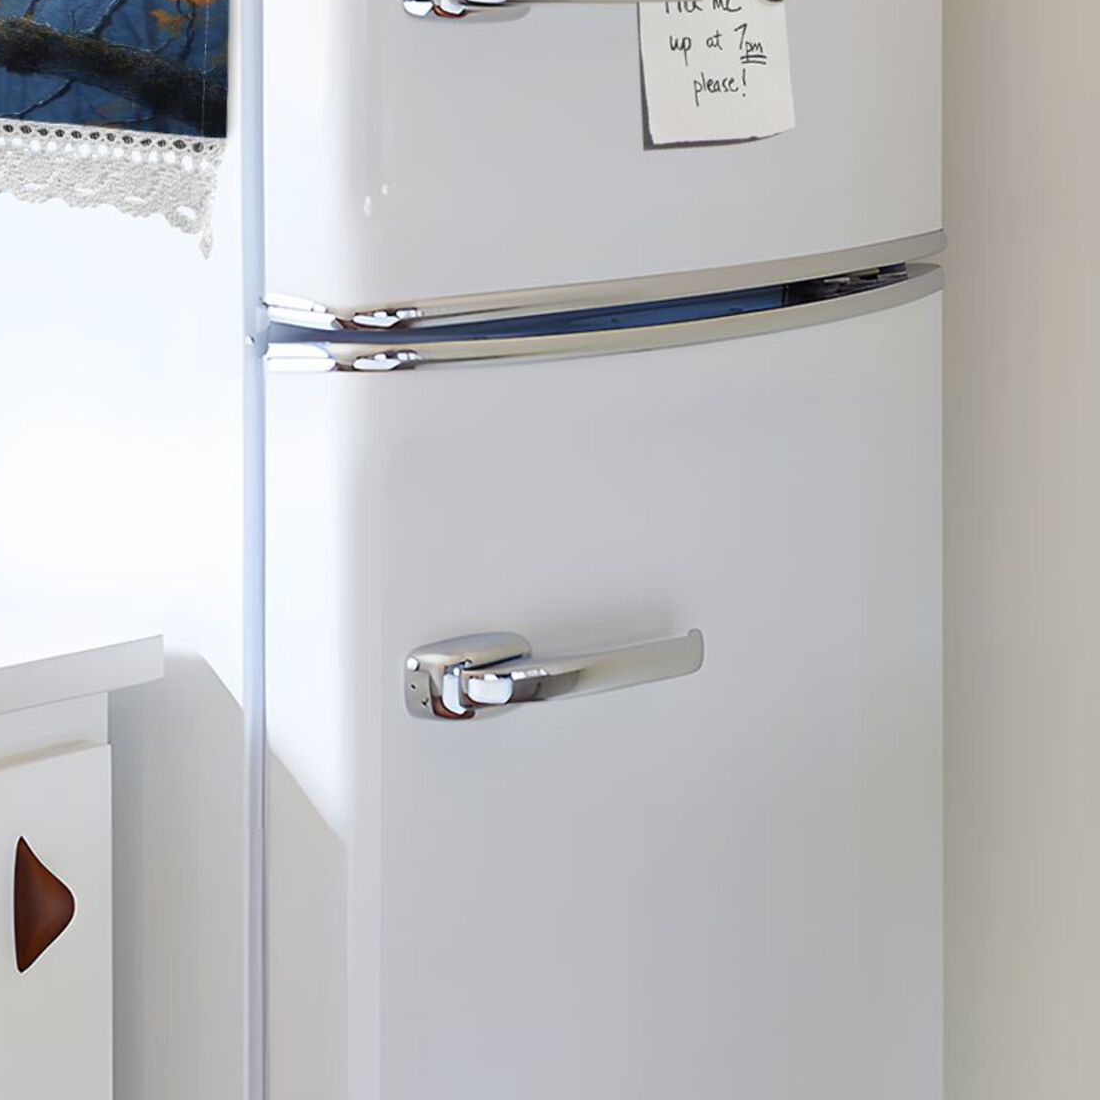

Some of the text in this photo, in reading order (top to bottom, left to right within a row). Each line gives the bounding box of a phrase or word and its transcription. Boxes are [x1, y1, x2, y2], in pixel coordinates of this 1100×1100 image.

[669, 35, 692, 67] up
[706, 30, 723, 51] at
[693, 68, 747, 108] please!
